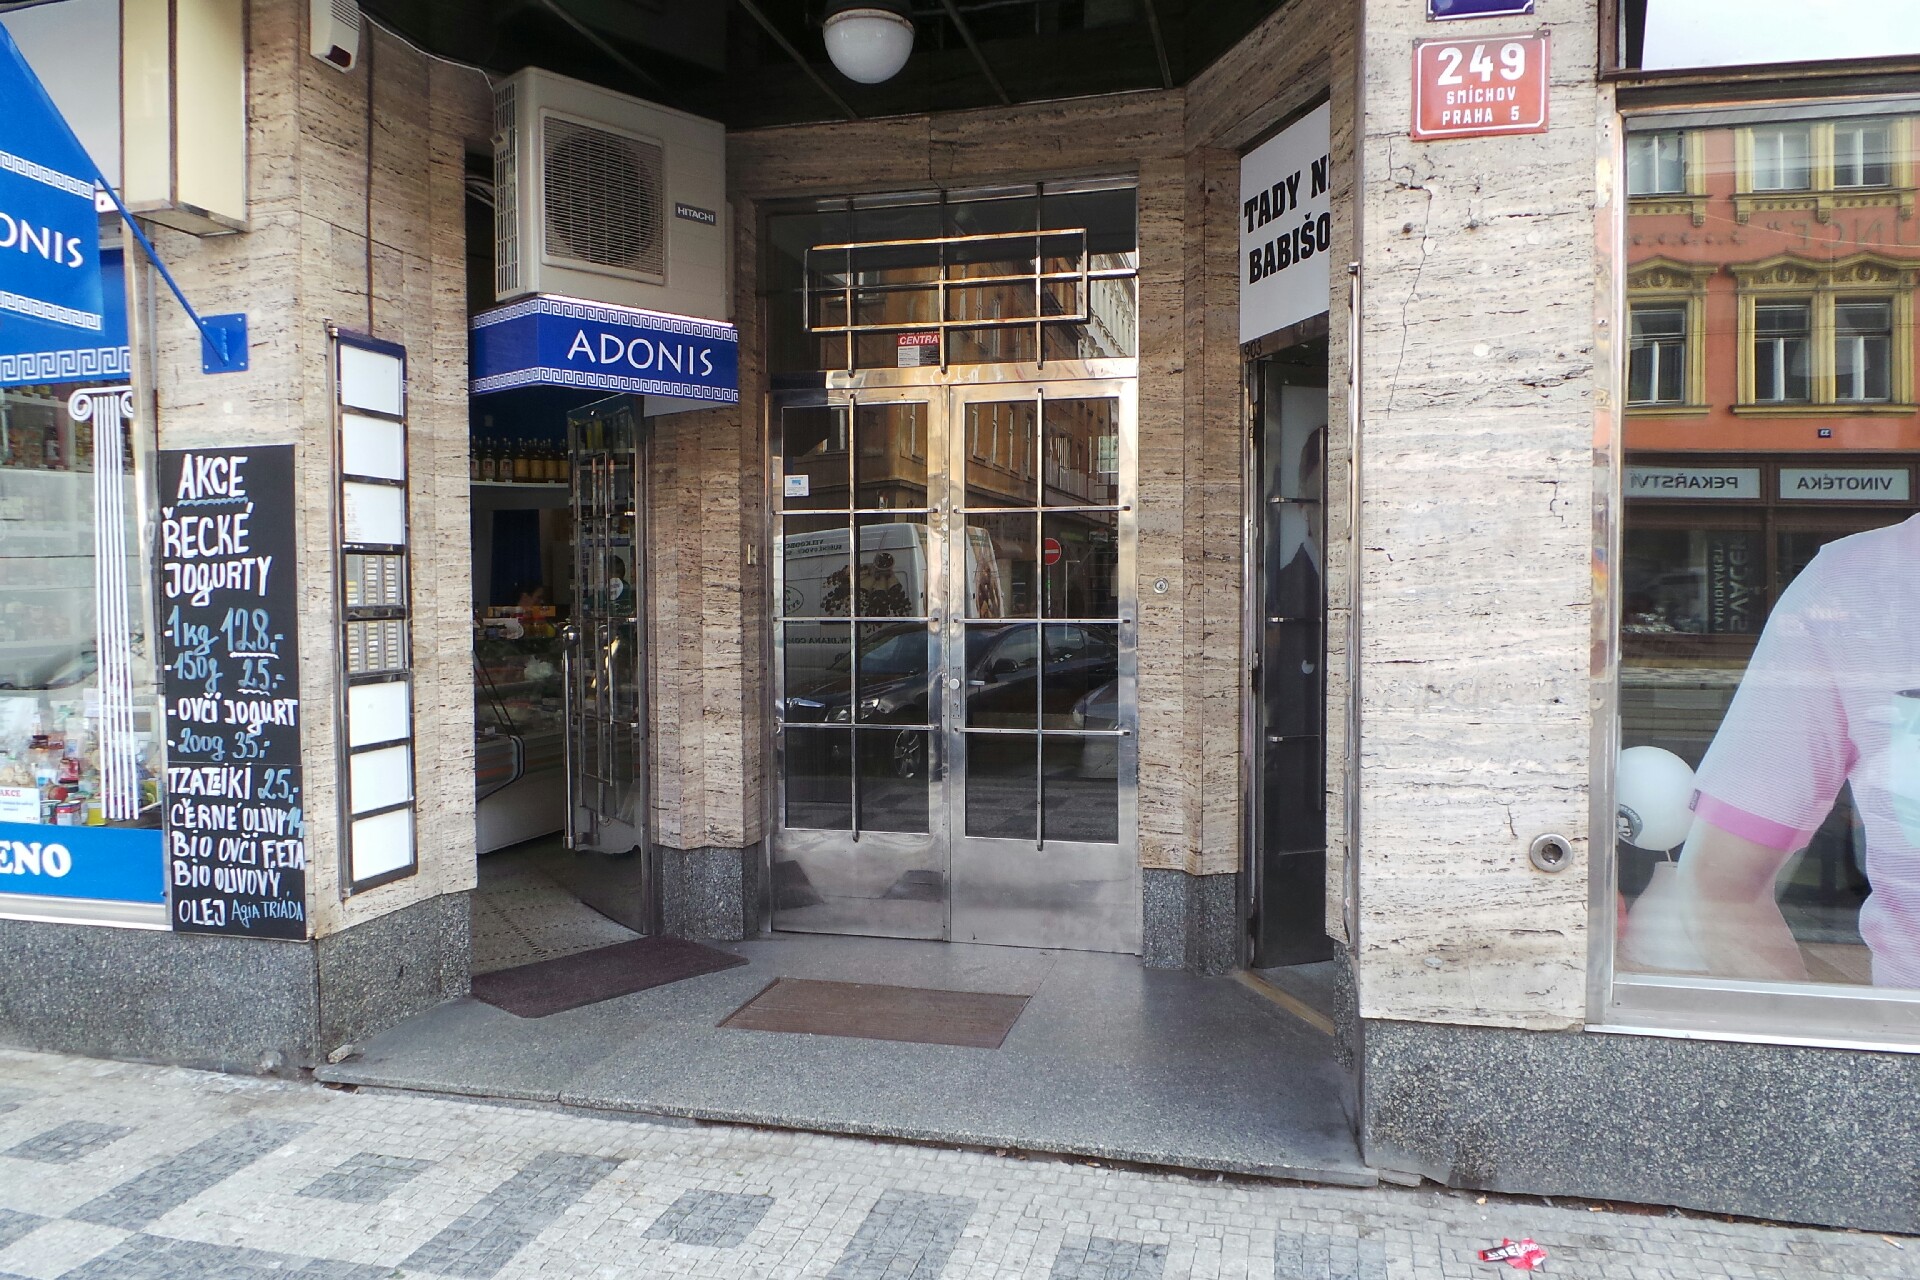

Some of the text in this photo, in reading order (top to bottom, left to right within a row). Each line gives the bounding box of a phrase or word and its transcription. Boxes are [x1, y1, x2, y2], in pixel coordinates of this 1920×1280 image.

[1437, 42, 1526, 86] 249
[1446, 85, 1517, 105] SMÍCHOV
[1442, 105, 1520, 126] PRAHA 5
[677, 206, 714, 223] HITACHI
[1243, 169, 1301, 234] TADY
[1249, 211, 1331, 286] BABIŠO
[567, 329, 713, 377] ADONIS
[1243, 338, 1262, 361] 903
[177, 453, 249, 500] AKCE
[162, 501, 254, 559] ŘECKÉ
[170, 798, 243, 831] ČERNÉ
[178, 898, 226, 927] OLEJ
